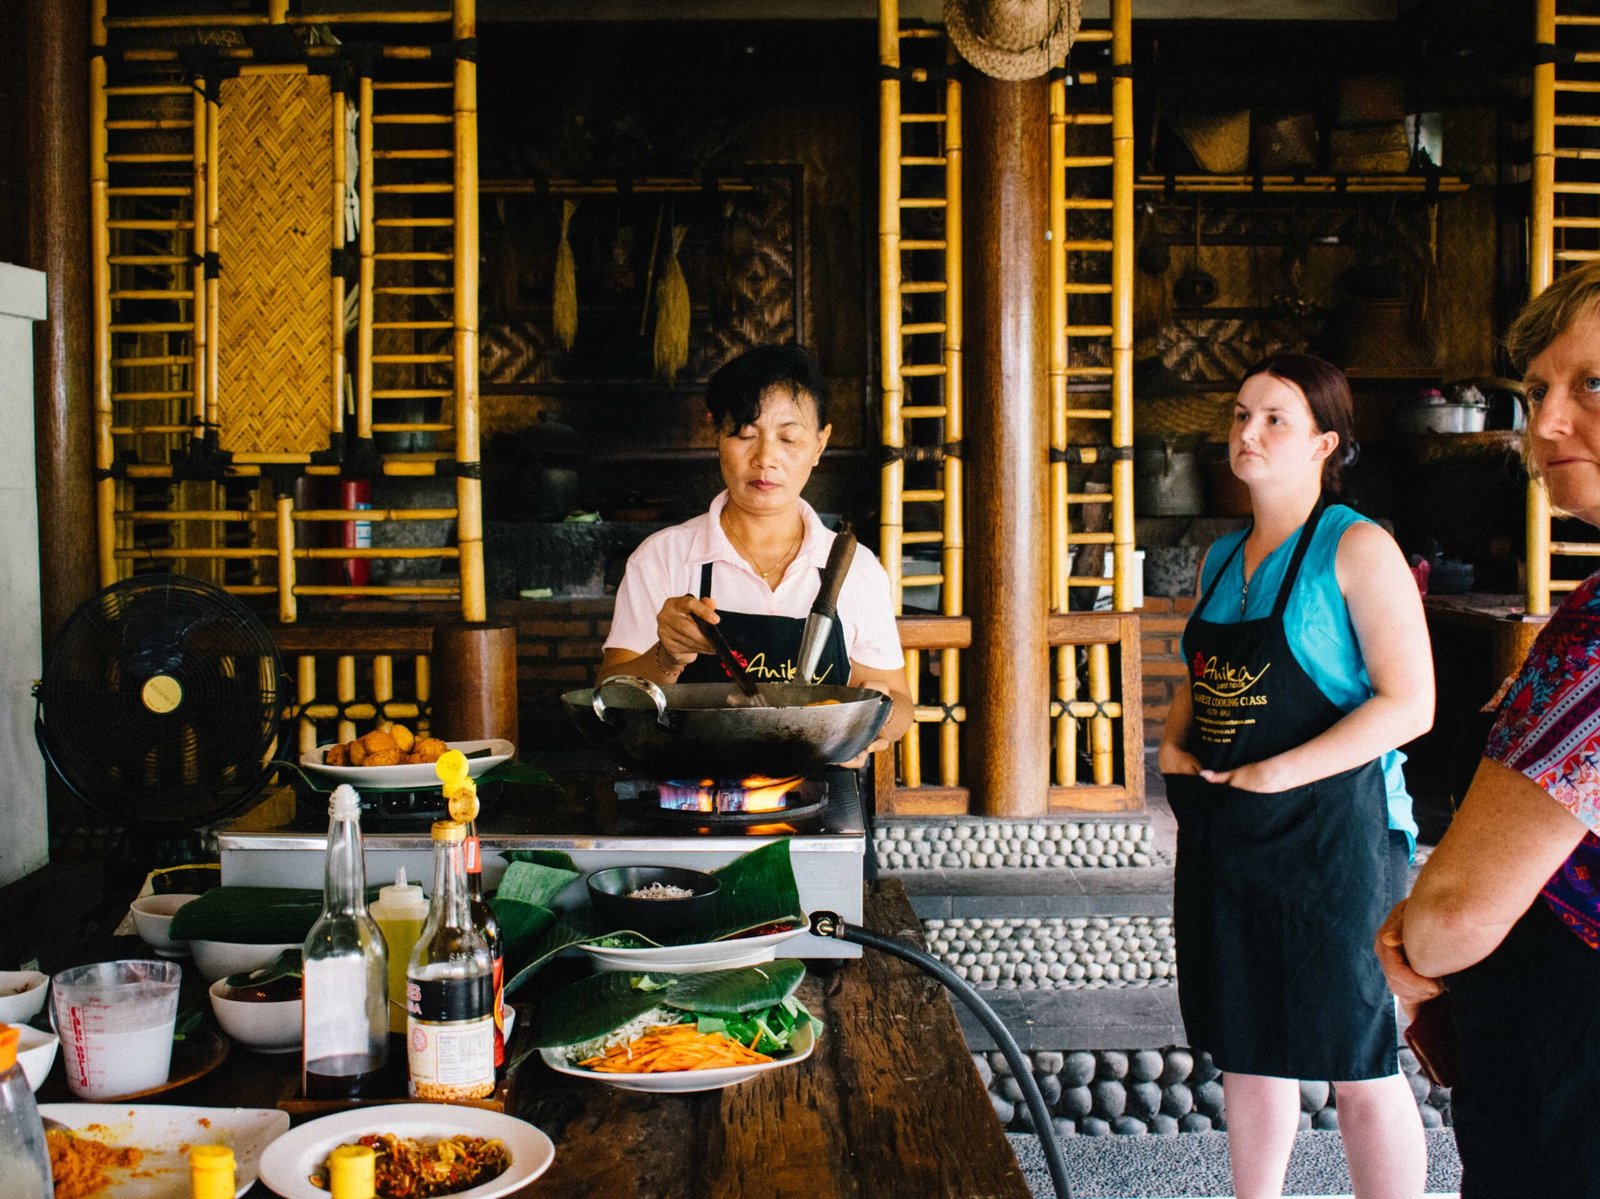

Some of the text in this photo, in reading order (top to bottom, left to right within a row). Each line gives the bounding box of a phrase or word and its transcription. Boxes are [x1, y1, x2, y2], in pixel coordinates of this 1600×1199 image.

[745, 652, 820, 681] Anik
[1203, 655, 1255, 682] Anika
[1211, 696, 1239, 707] COOKING
[1240, 695, 1268, 706] CLASS
